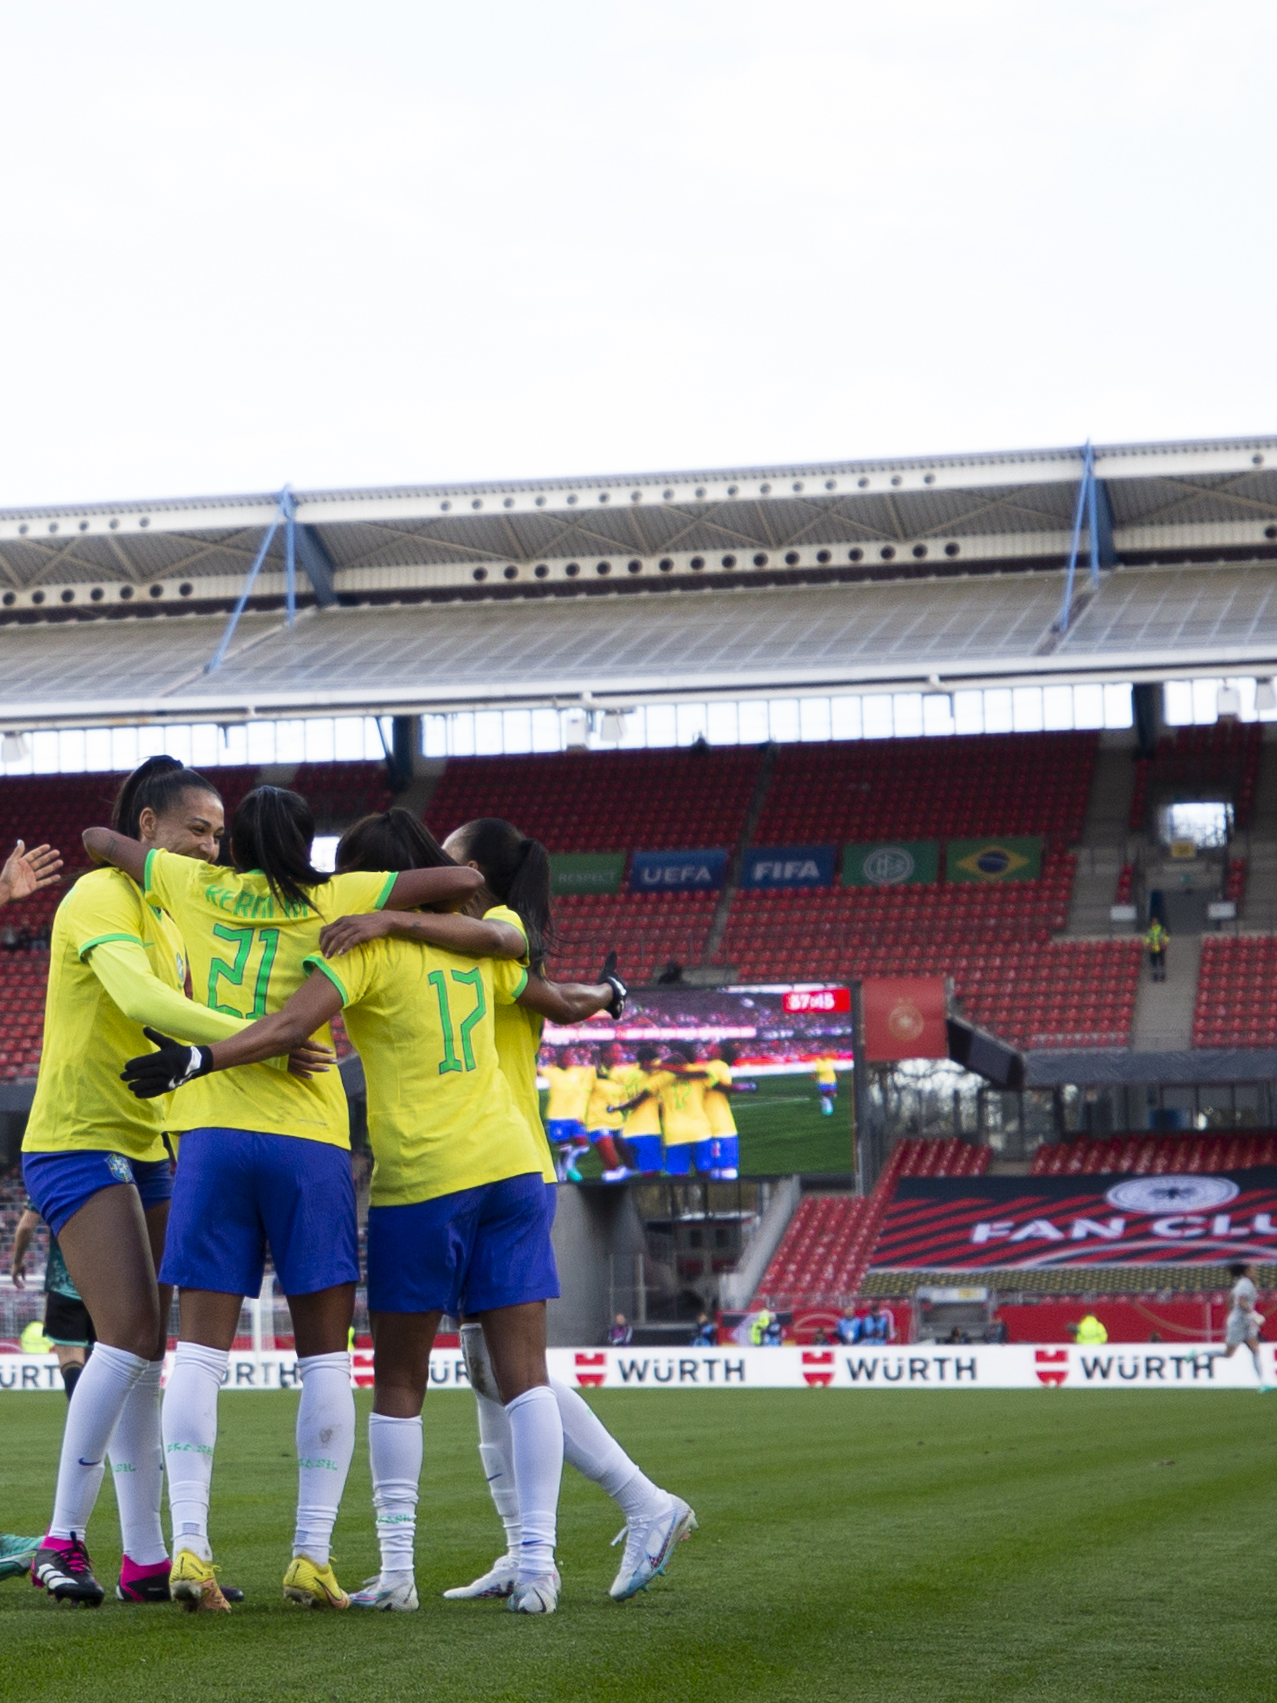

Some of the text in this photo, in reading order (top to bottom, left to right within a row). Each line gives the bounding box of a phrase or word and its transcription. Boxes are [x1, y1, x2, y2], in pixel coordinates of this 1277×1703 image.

[558, 871, 616, 885] RESPECT
[640, 864, 713, 884] UEFA
[753, 860, 821, 882] FIFA
[207, 923, 280, 1020] 21
[427, 967, 487, 1075] 17
[970, 1217, 1126, 1244] FAN
[618, 1358, 745, 1383] WÜRTH
[846, 1357, 977, 1382] WÜRTH
[1080, 1355, 1215, 1380] WÜRTH
